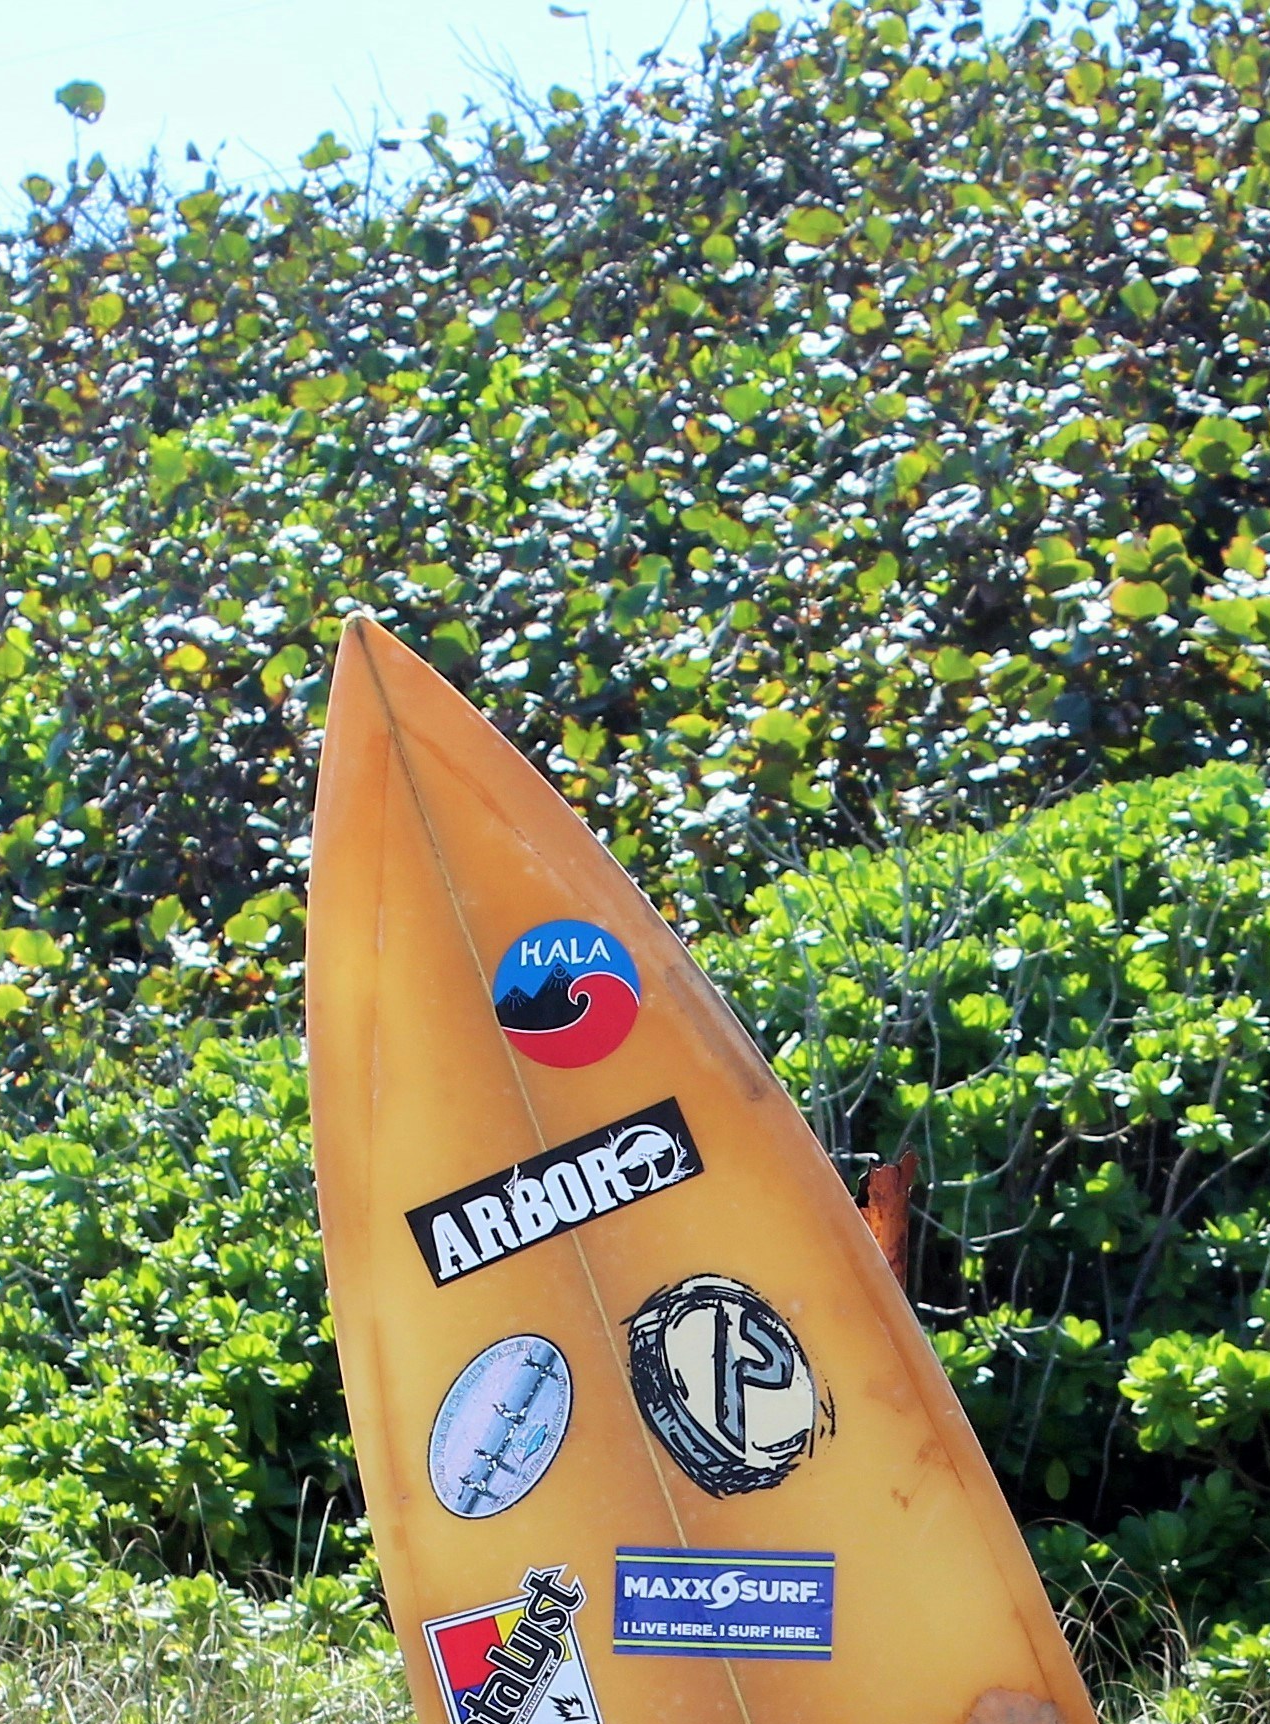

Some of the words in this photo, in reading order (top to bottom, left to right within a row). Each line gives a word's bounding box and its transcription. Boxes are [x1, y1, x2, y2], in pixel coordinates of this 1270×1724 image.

[520, 937, 611, 966] HALA
[431, 1146, 635, 1281] ARBOR
[623, 1621, 629, 1633] I
[631, 1622, 667, 1635] LIVE
[670, 1623, 717, 1637] HERE.
[720, 1624, 725, 1636] I
[728, 1625, 771, 1638] SURF
[773, 1626, 820, 1640] HERE.
